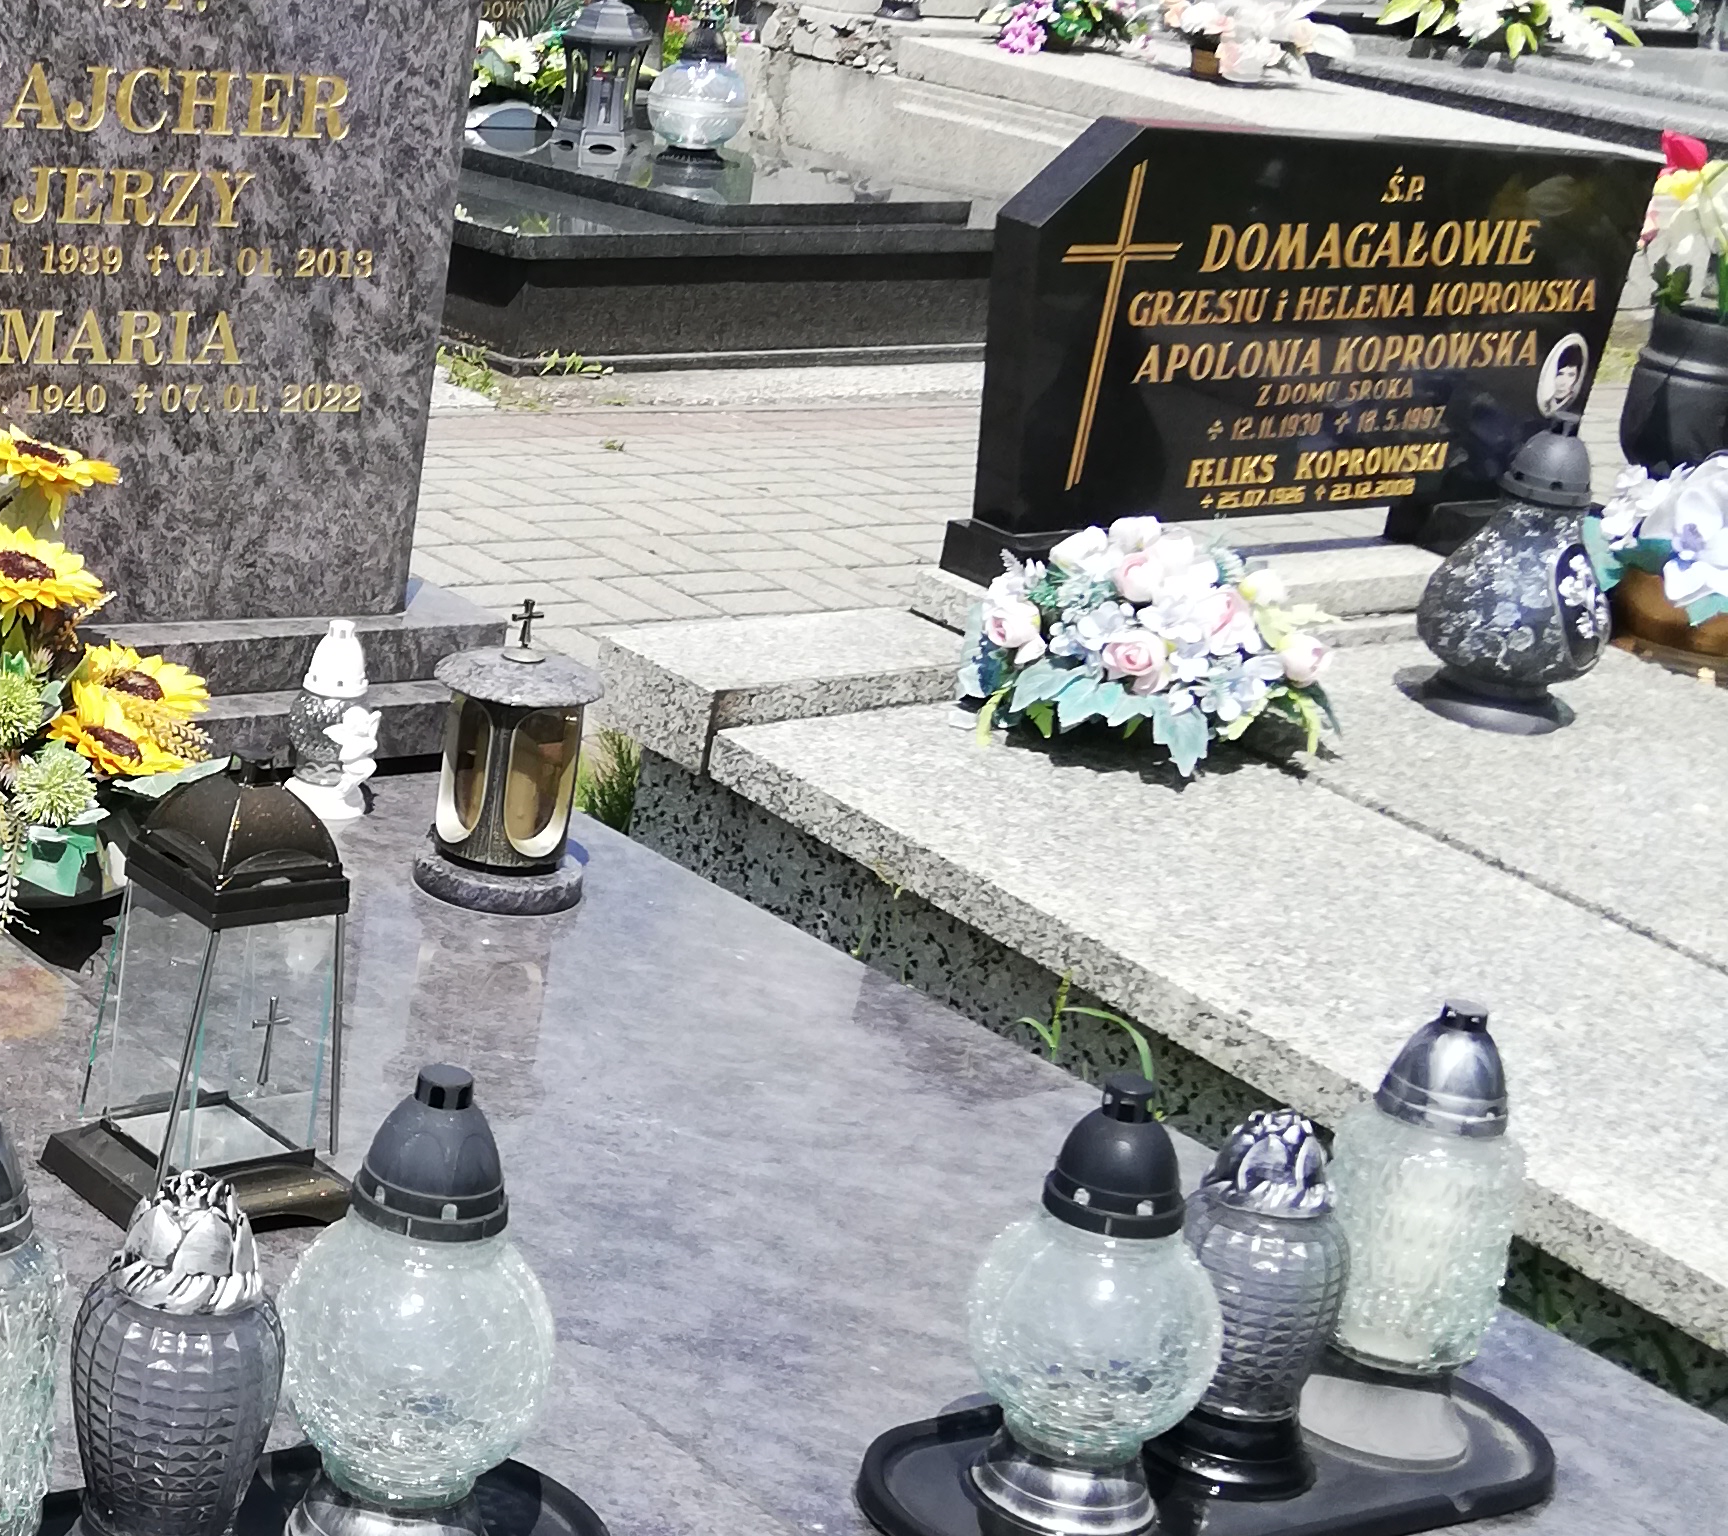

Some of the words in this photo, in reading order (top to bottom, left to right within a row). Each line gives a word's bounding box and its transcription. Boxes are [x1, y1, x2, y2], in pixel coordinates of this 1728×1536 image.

[12, 165, 256, 228] JERZY
[40, 243, 123, 276] 1939
[293, 248, 373, 280] 2013
[1198, 217, 1542, 274] DOMAGAŁOWIE
[1127, 287, 1271, 328] GRZESIU
[1292, 283, 1416, 322] HELENA
[1422, 278, 1597, 318] KOPROWSKA
[0, 307, 243, 366] MARIA
[1131, 337, 1323, 385] APOLONIA
[1330, 329, 1538, 376] KOPROWSKA
[26, 383, 107, 415] 1940
[280, 383, 362, 415] 2022
[1255, 383, 1273, 407] Z
[1274, 380, 1341, 406] DOMU
[1347, 377, 1414, 403] SROKA
[1185, 453, 1279, 489] FELIKS
[1293, 441, 1450, 481] KOPROWSKI
